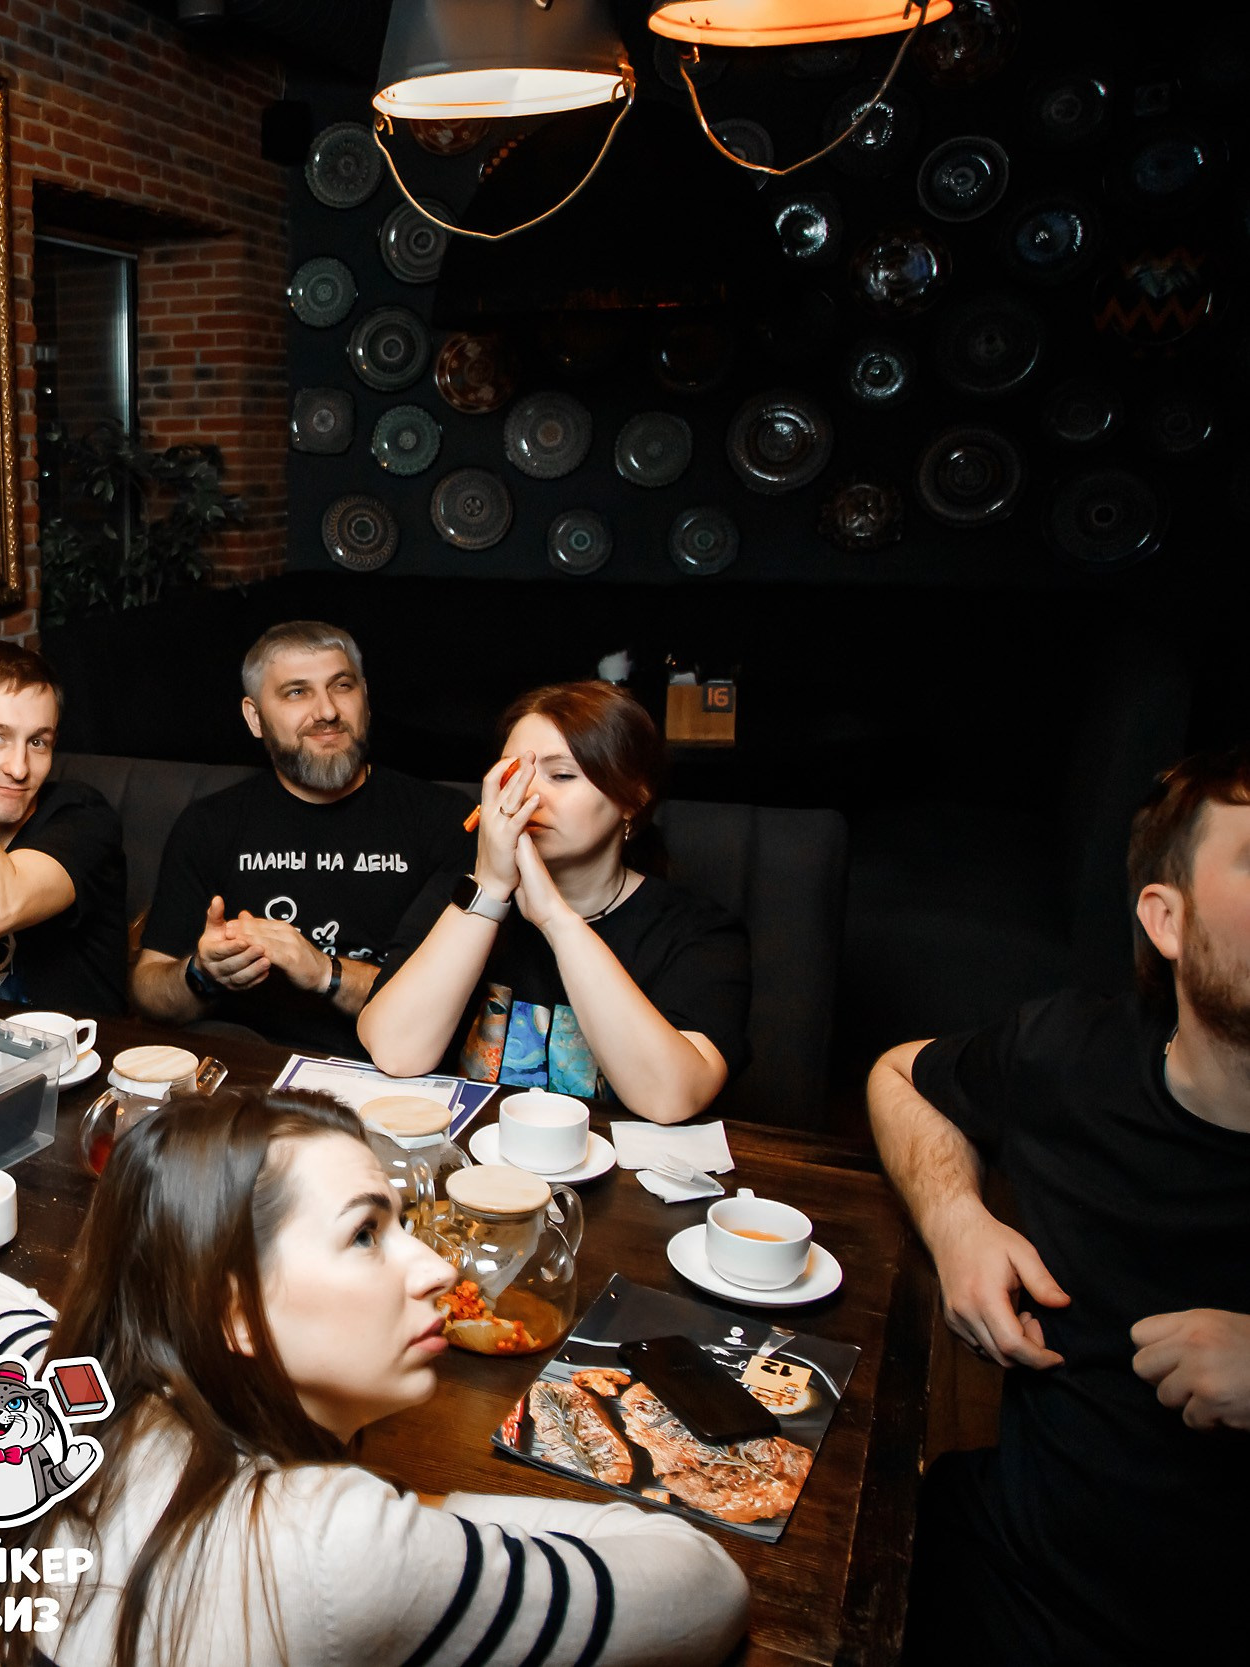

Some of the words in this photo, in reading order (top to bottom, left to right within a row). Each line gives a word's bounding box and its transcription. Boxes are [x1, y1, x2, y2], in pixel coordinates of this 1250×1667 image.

[707, 687, 730, 707] 16
[239, 851, 307, 872] ПЛАНЫ
[316, 852, 345, 872] НА
[352, 852, 409, 873] ДЕНЬ
[760, 1359, 793, 1377] 12
